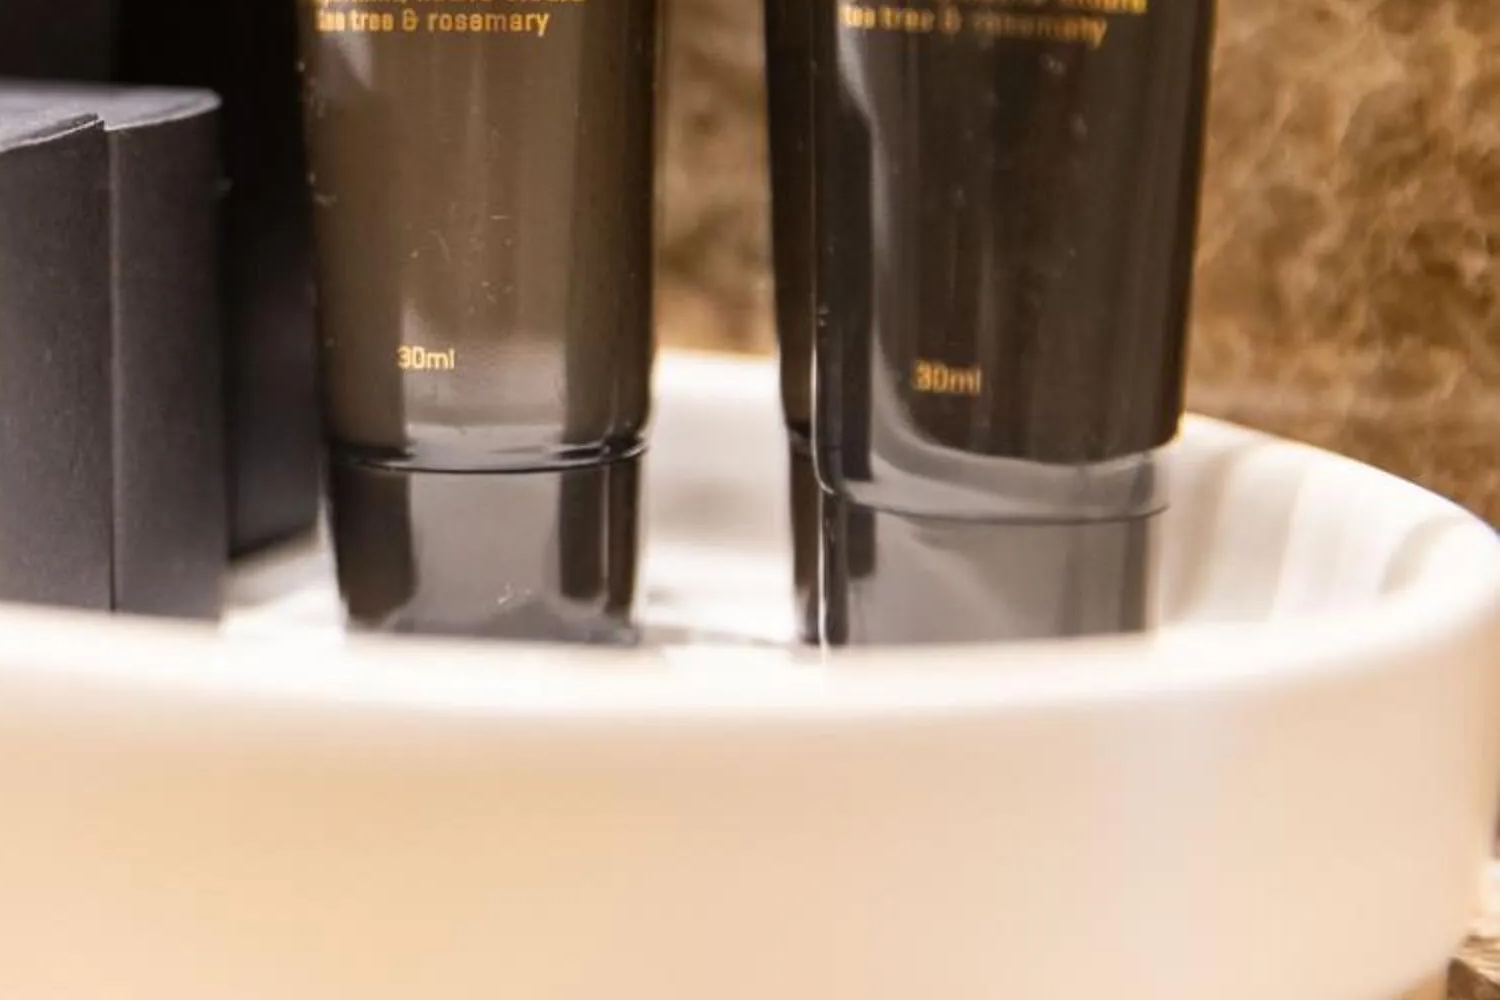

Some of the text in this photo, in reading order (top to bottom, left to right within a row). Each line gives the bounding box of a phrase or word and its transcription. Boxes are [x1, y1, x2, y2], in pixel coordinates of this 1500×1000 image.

[351, 9, 395, 32] tree
[402, 7, 420, 31] &
[427, 9, 550, 37] rosemary
[396, 344, 455, 370] 30ml
[914, 360, 982, 394] 30ml
